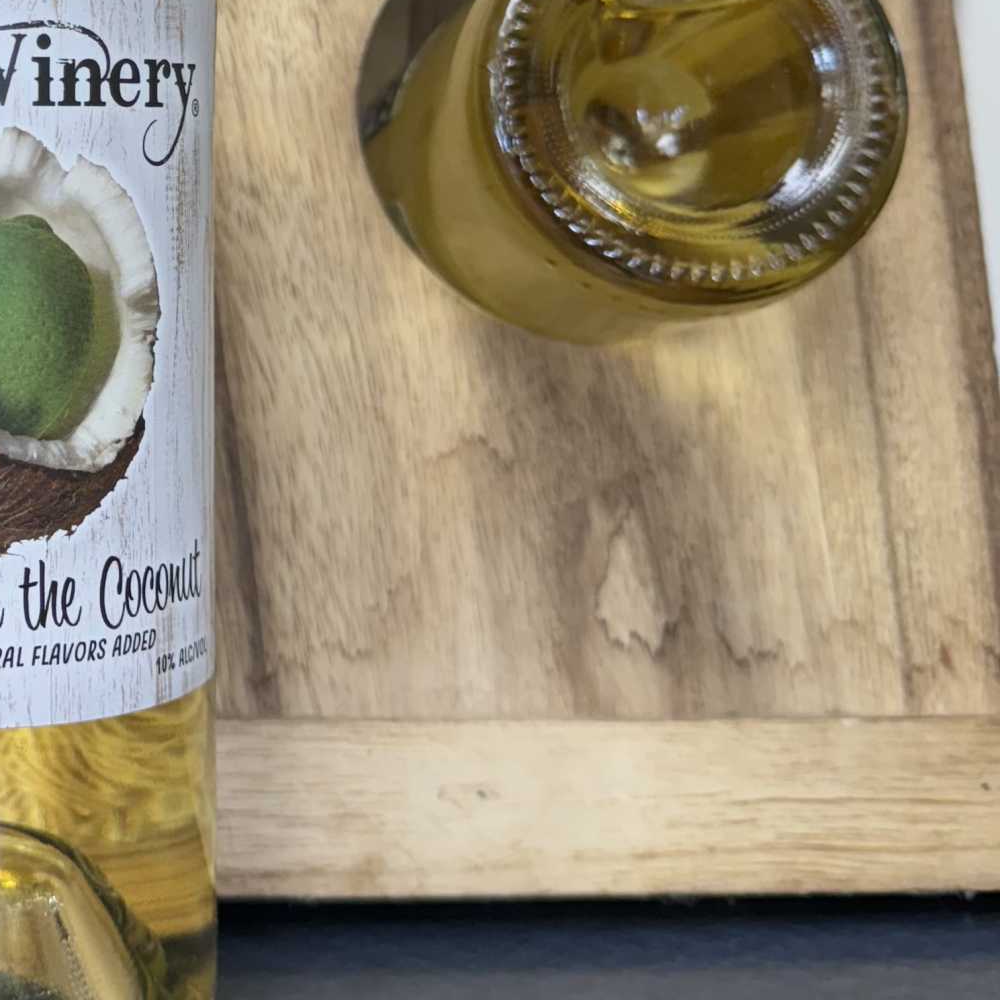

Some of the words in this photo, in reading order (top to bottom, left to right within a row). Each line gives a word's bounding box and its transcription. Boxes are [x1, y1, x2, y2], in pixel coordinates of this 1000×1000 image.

[18, 559, 83, 632] the
[99, 539, 201, 630] Coconut
[32, 638, 107, 667] FLAVORS
[112, 627, 157, 657] ADDED
[156, 652, 176, 675] 10%
